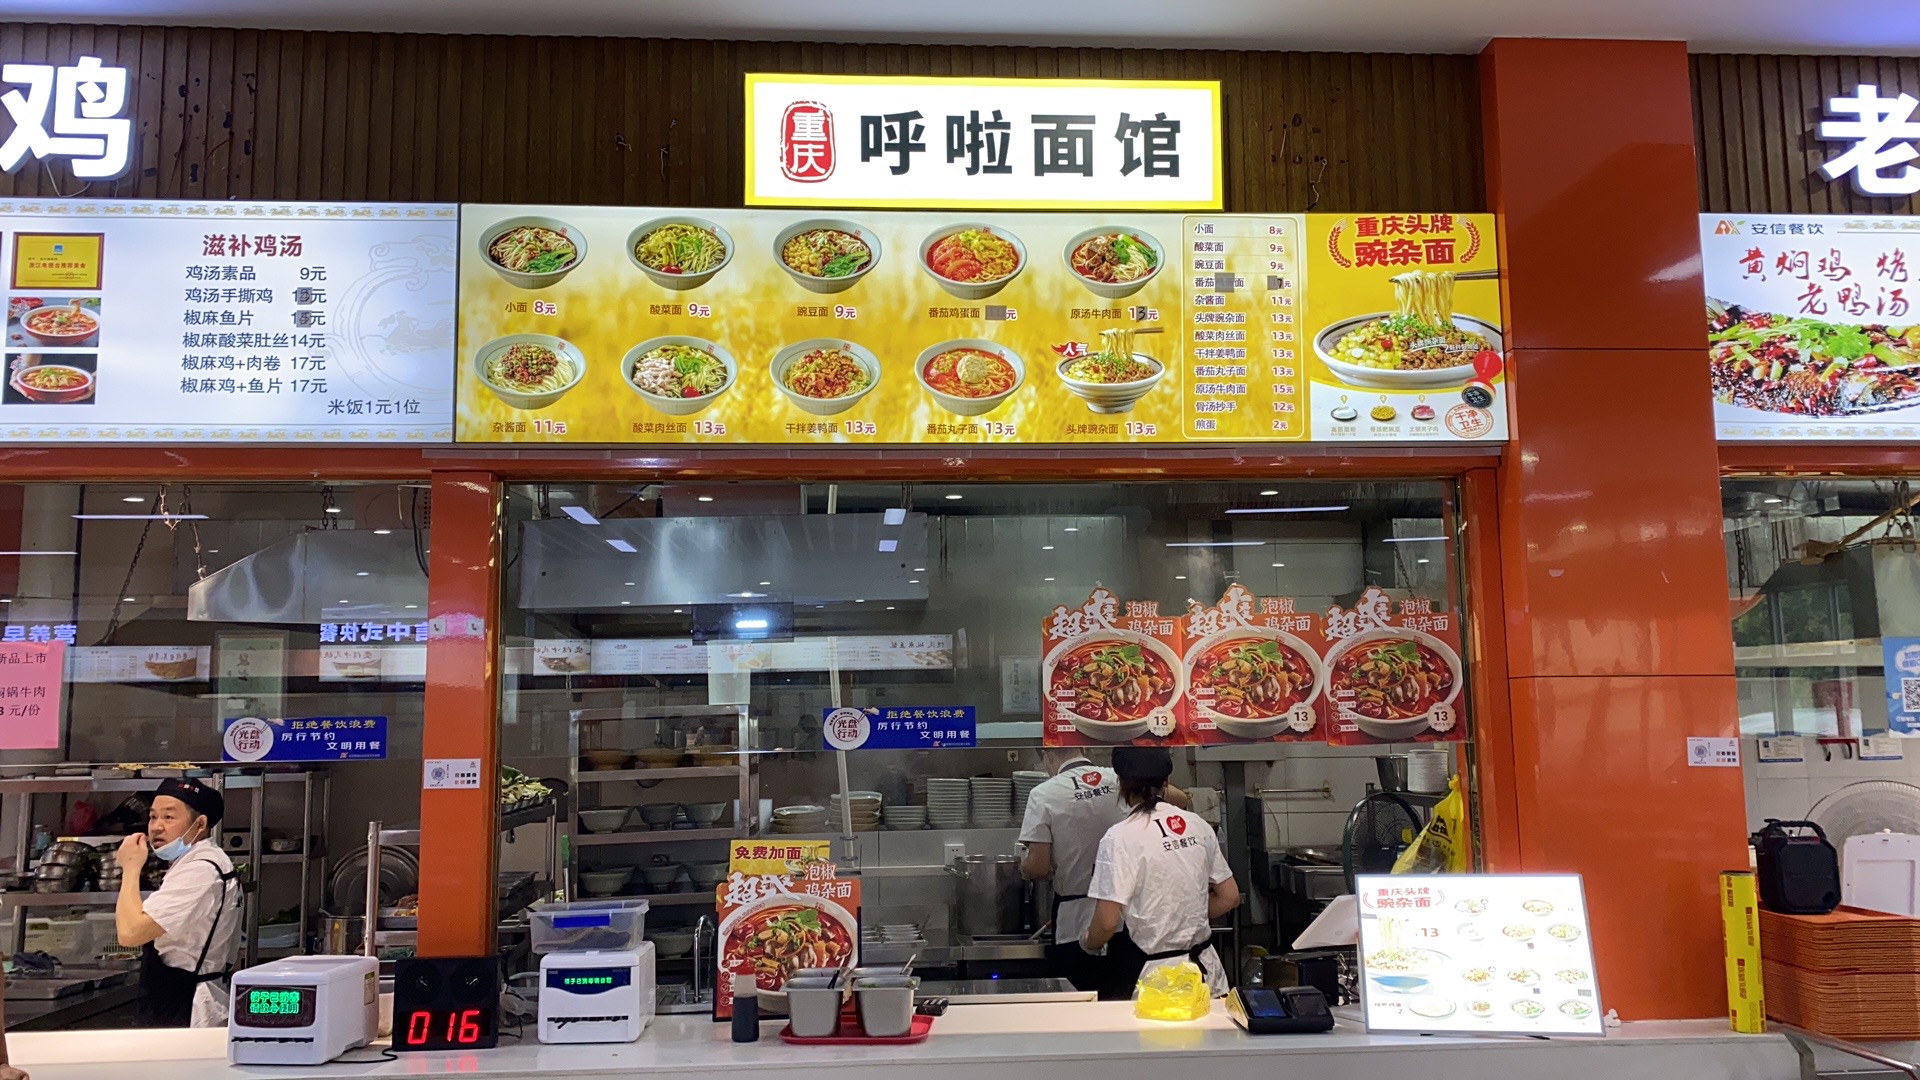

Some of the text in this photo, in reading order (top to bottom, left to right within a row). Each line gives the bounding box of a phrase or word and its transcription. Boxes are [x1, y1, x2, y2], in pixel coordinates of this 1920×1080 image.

[0, 56, 131, 178] 鸡
[790, 110, 827, 175] 重庆
[860, 109, 1182, 178] 呼啦面馆
[1821, 83, 1920, 194] 老
[1194, 224, 1283, 235] 小面 8元
[1354, 214, 1454, 238] 重庆头牌
[1751, 223, 1824, 235] 安信餐饮
[202, 234, 302, 257] 滋补鸡汤
[1194, 242, 1284, 253] 酸菜面 9元
[1354, 238, 1456, 266] 豌杂面
[1194, 260, 1284, 270] 豌豆面 9元
[1738, 246, 1920, 283] 黄焖鸡 烤
[185, 265, 327, 281] 鸡汤素品 9元
[1195, 277, 1245, 288] 番茄面
[184, 287, 273, 303] 鸡汤手撕鸡
[1195, 295, 1292, 305] 杂酱面 11元
[1797, 281, 1910, 318] 老鸭汤
[505, 301, 556, 315] 小面 8元
[650, 303, 711, 317] 酸菜面 9元
[796, 305, 856, 318] 豌豆面 9元
[928, 307, 980, 319] 番茄鸡蛋面
[1070, 307, 1122, 320] 原汤牛肉面
[183, 309, 254, 326] 椒麻鱼片
[1195, 313, 1292, 323] 头牌豌杂面 13元
[1195, 331, 1292, 340] 酸菜肉丝面 13元
[1062, 342, 1088, 356] 人气
[1195, 348, 1293, 358] 干拌姜鸭面 13元
[181, 354, 326, 371] 椒麻鸡+肉卷 17元
[1196, 366, 1293, 376] 番茄丸子面 13元
[180, 377, 327, 394] 椒麻鸡+鱼片 17元
[1196, 384, 1293, 394] 原汤牛肉面 15元
[327, 398, 421, 415] 米饭1元1位
[1196, 402, 1294, 412] 骨汤抄手 12元
[492, 420, 566, 434] 杂酱面 11元
[632, 421, 725, 435] 酸菜肉丝面 13元
[785, 421, 876, 435] 干拌姜鸭面 13元
[926, 422, 1015, 436] 番茄丸子面 13元
[1066, 422, 1156, 436] 头牌豌杂面 13元
[1196, 419, 1287, 430] 煎蛋 2元
[1127, 602, 1159, 617] 泡椒
[1263, 599, 1294, 614] 泡椒
[1400, 599, 1431, 615] 泡椒
[1128, 619, 1174, 635] 鸡杂面
[1264, 615, 1311, 631] 鸡杂面
[1402, 615, 1449, 632] 鸡杂面
[886, 710, 965, 719] 拒绝餐饮浪费
[1153, 715, 1168, 726] 13
[1294, 711, 1308, 722] 13
[1434, 711, 1448, 721] 13
[290, 720, 377, 730] 拒绝餐饮浪费
[837, 719, 858, 728] 光盘
[877, 721, 928, 730] 厉行节约
[238, 730, 261, 740] 光盘
[281, 732, 336, 741] 厉行节约
[837, 729, 858, 738] 行动
[920, 730, 971, 739] 文明用餐
[238, 740, 261, 750] 行动
[326, 741, 381, 751] 文明用餐
[1070, 776, 1081, 790] I
[1153, 819, 1168, 838] I
[1162, 836, 1198, 852] 安信餐饮
[734, 846, 802, 860] 免费加面
[804, 864, 837, 880] 泡椒
[805, 882, 852, 899] 鸡杂面
[407, 1010, 480, 1044] 016
